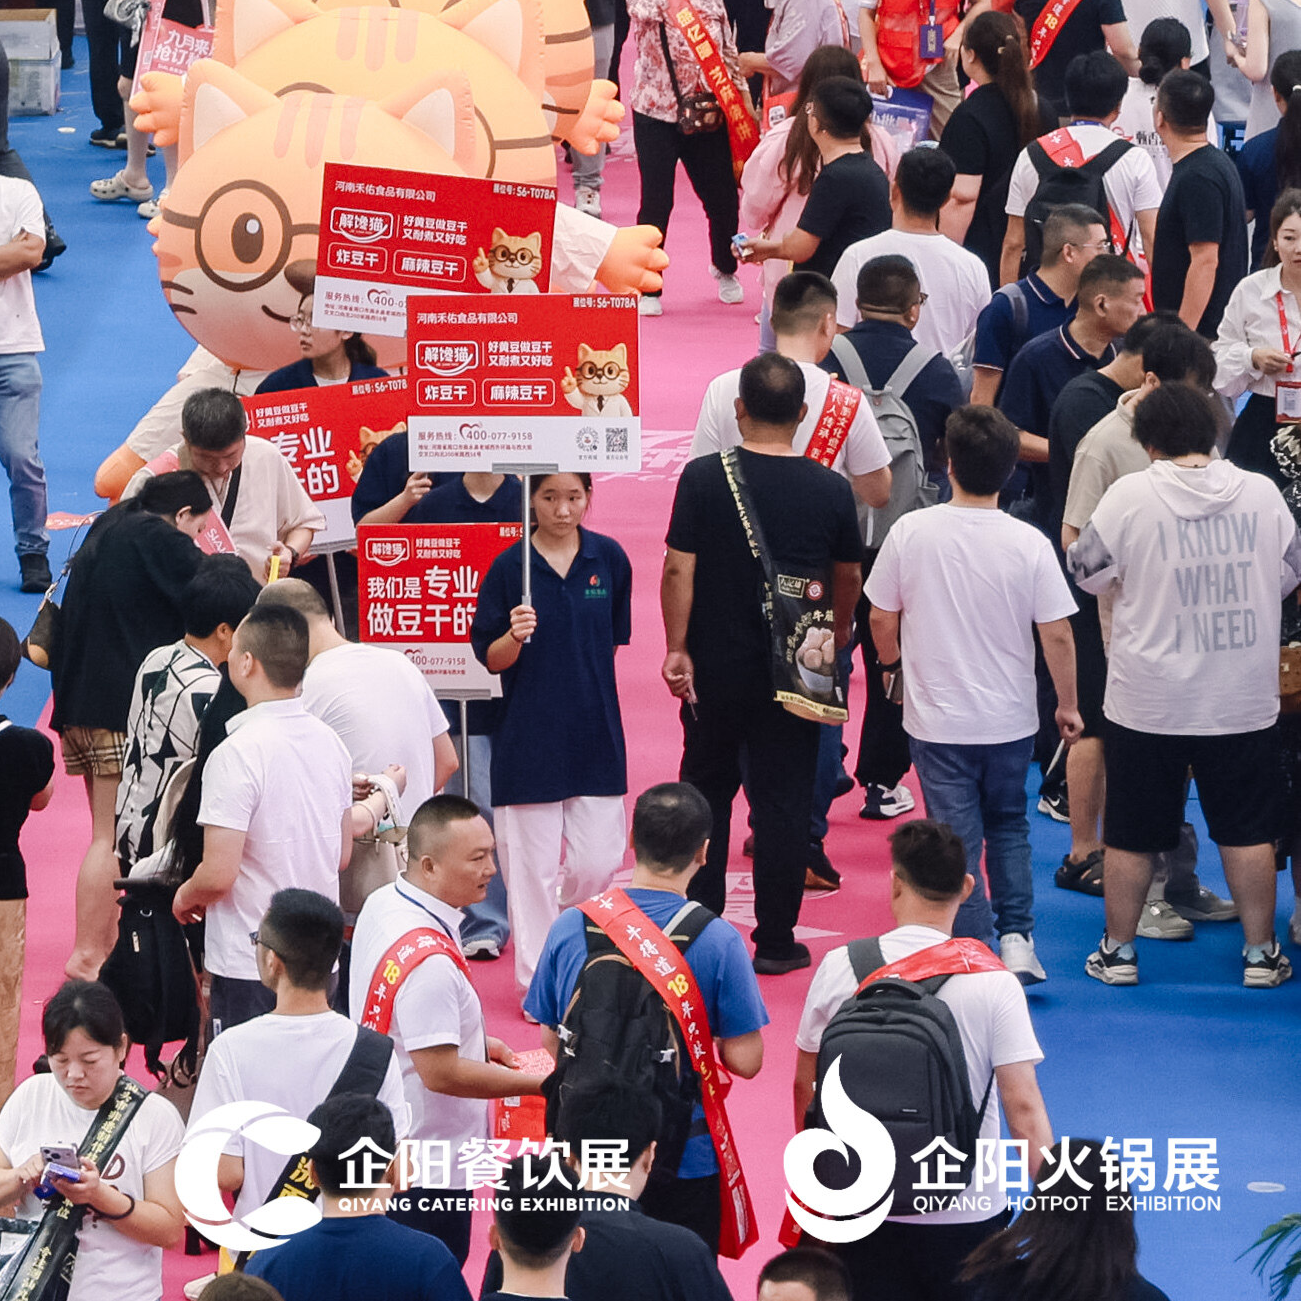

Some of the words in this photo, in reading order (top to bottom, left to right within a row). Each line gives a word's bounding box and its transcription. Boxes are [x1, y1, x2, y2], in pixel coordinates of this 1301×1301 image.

[334, 180, 436, 203] 河南禾佑食品有限公司
[403, 214, 468, 233] 好黄豆做豆干
[401, 228, 467, 246] 又耐煮又好吃
[336, 248, 380, 267] 炸豆干
[401, 256, 459, 277] 麻辣豆干
[416, 312, 519, 326] 河南禾佑食品有限公司
[487, 341, 553, 355] 好黄豆做豆干
[487, 354, 553, 368] 又耐煮又好吃
[351, 378, 409, 396] 展位号:S6-T078
[424, 385, 468, 402] 炸豆干
[490, 385, 548, 402] 麻辣豆干
[465, 429, 534, 442] 400-077-9158
[1176, 511, 1259, 560] KNOW
[1174, 560, 1252, 608] WHAT
[366, 602, 477, 637] 做豆干的
[1191, 608, 1257, 654] NEED
